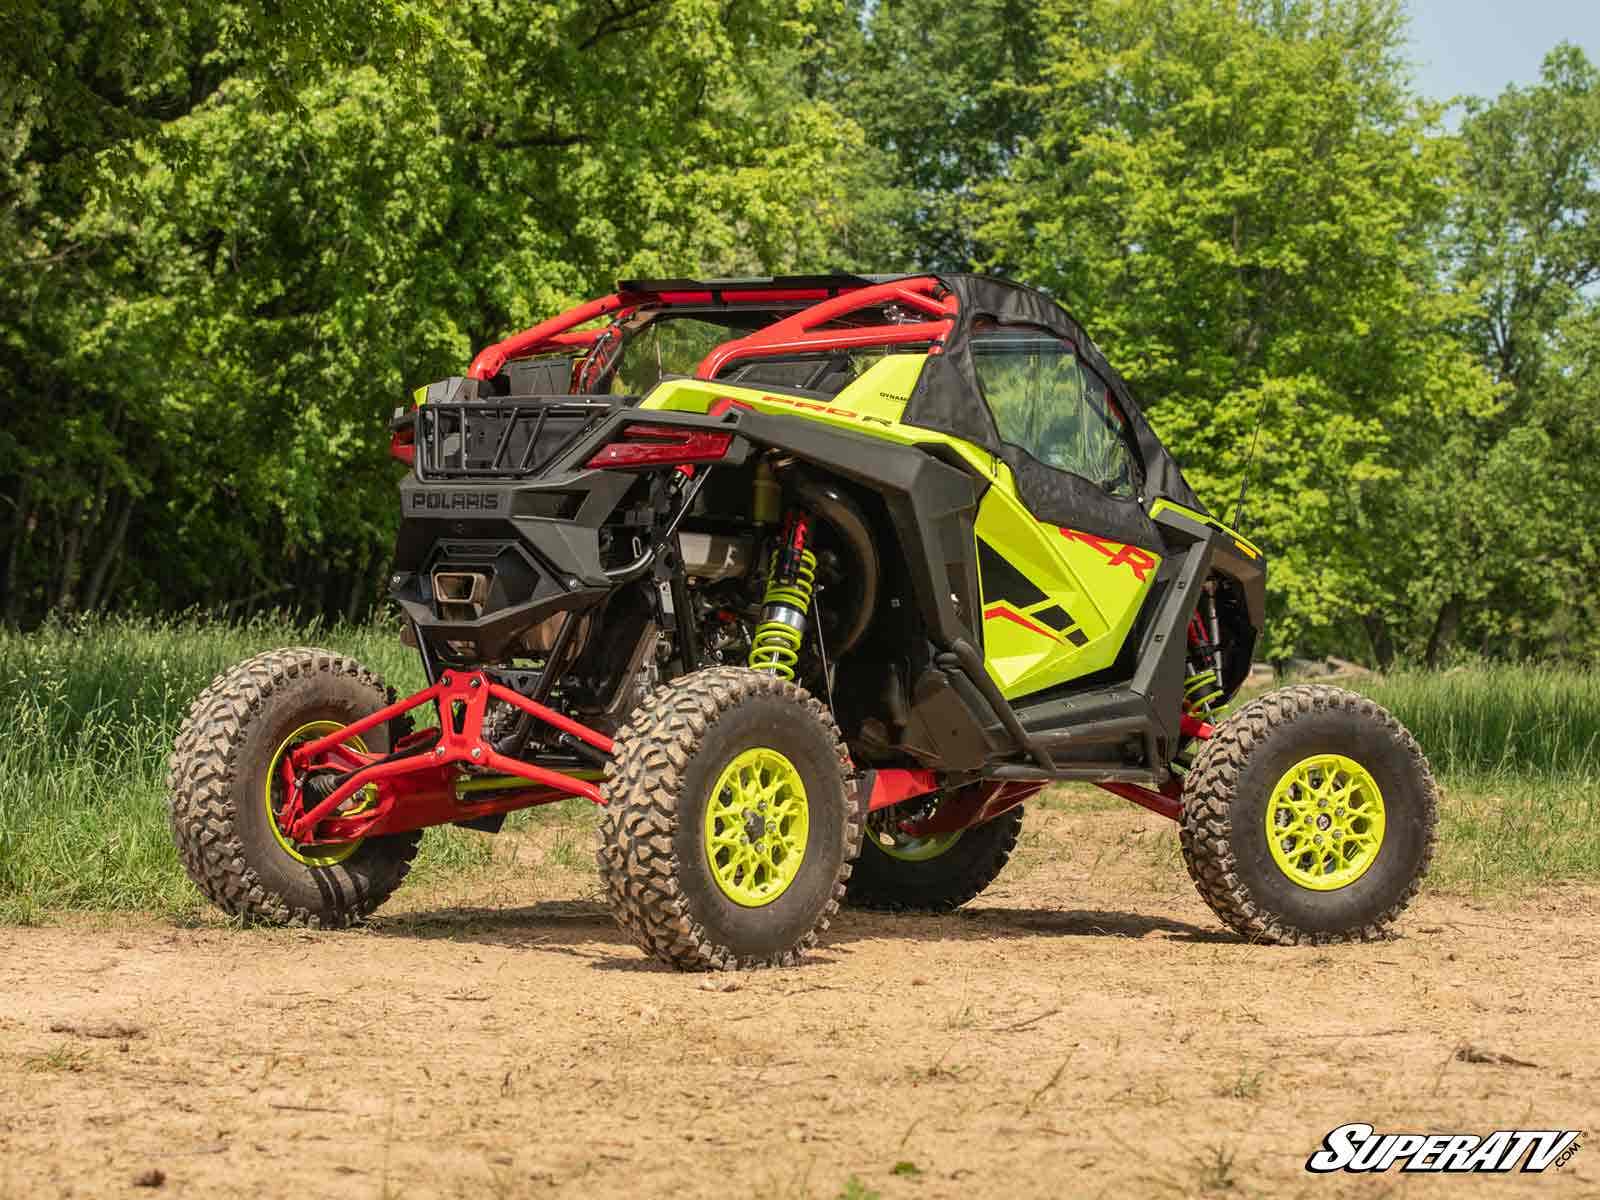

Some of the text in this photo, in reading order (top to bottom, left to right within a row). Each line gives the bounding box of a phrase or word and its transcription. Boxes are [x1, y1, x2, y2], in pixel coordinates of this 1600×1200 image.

[761, 395, 892, 427] PRO R
[412, 493, 499, 510] POLARIS
